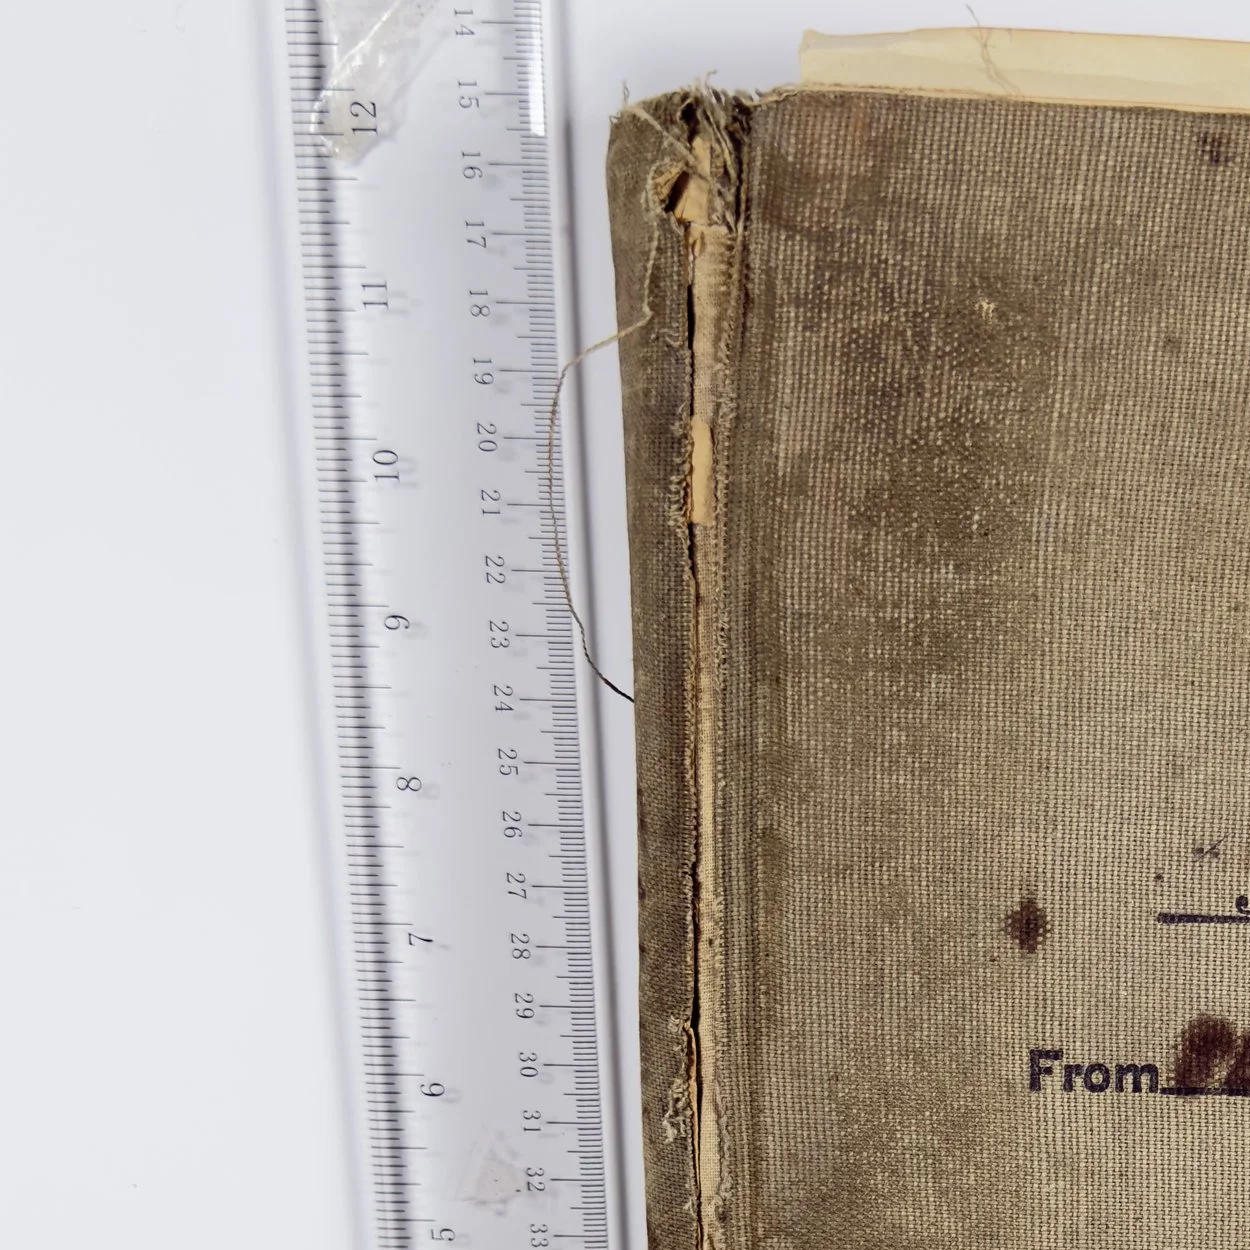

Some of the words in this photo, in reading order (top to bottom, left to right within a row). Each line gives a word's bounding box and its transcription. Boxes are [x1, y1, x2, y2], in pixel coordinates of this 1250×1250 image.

[454, 9, 476, 37] 14
[458, 80, 480, 109] 15
[350, 101, 378, 135] 12
[461, 151, 483, 180] 16
[465, 221, 486, 249] 17
[361, 280, 388, 309] 11
[469, 290, 490, 318] 18
[473, 358, 494, 385] 19
[476, 423, 498, 452] 20
[372, 450, 399, 481] 10
[480, 489, 501, 516] 21
[484, 555, 506, 584] 22
[384, 614, 410, 630] 9
[489, 621, 510, 649] 23
[493, 685, 514, 712] 24
[497, 748, 519, 776] 25
[396, 776, 422, 792] 8
[502, 811, 523, 838] 26
[506, 872, 527, 899] 27
[408, 933, 433, 947] 7
[510, 933, 531, 960] 28
[514, 993, 535, 1019] 29
[519, 1052, 538, 1078] 30
[1029, 1049, 1159, 1093] From
[420, 1082, 445, 1097] 6
[522, 1110, 542, 1132] 31
[526, 1167, 546, 1192] 32
[431, 1228, 456, 1242] 5
[530, 1223, 549, 1248] 33
